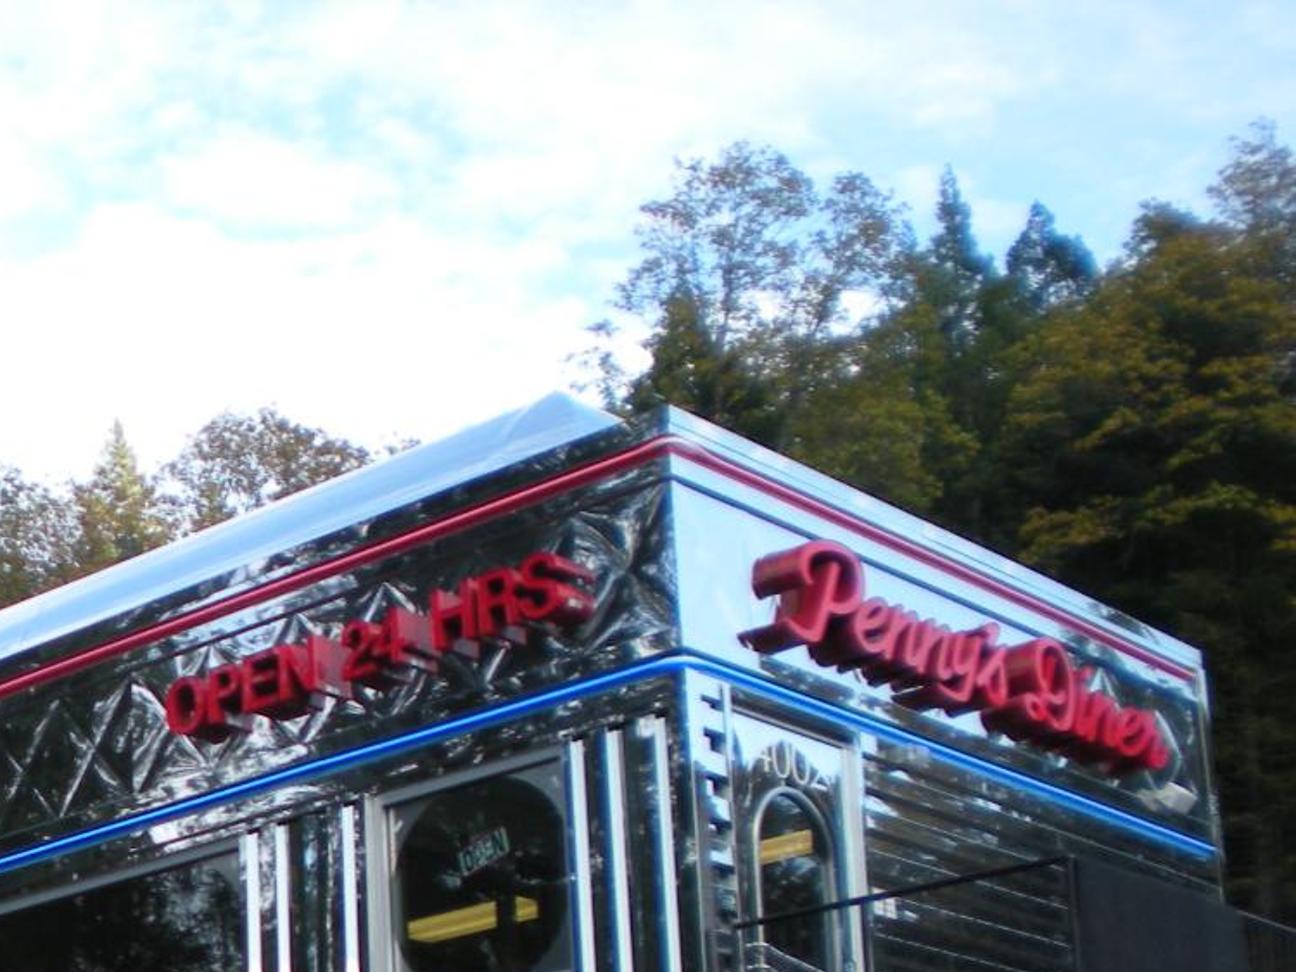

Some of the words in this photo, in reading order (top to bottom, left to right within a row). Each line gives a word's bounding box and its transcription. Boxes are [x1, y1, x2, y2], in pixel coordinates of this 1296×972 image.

[166, 636, 336, 742] OPEN
[342, 607, 432, 682] 24
[430, 552, 593, 658] HRS
[739, 540, 1007, 710] Penny's
[1004, 637, 1169, 771] Diner
